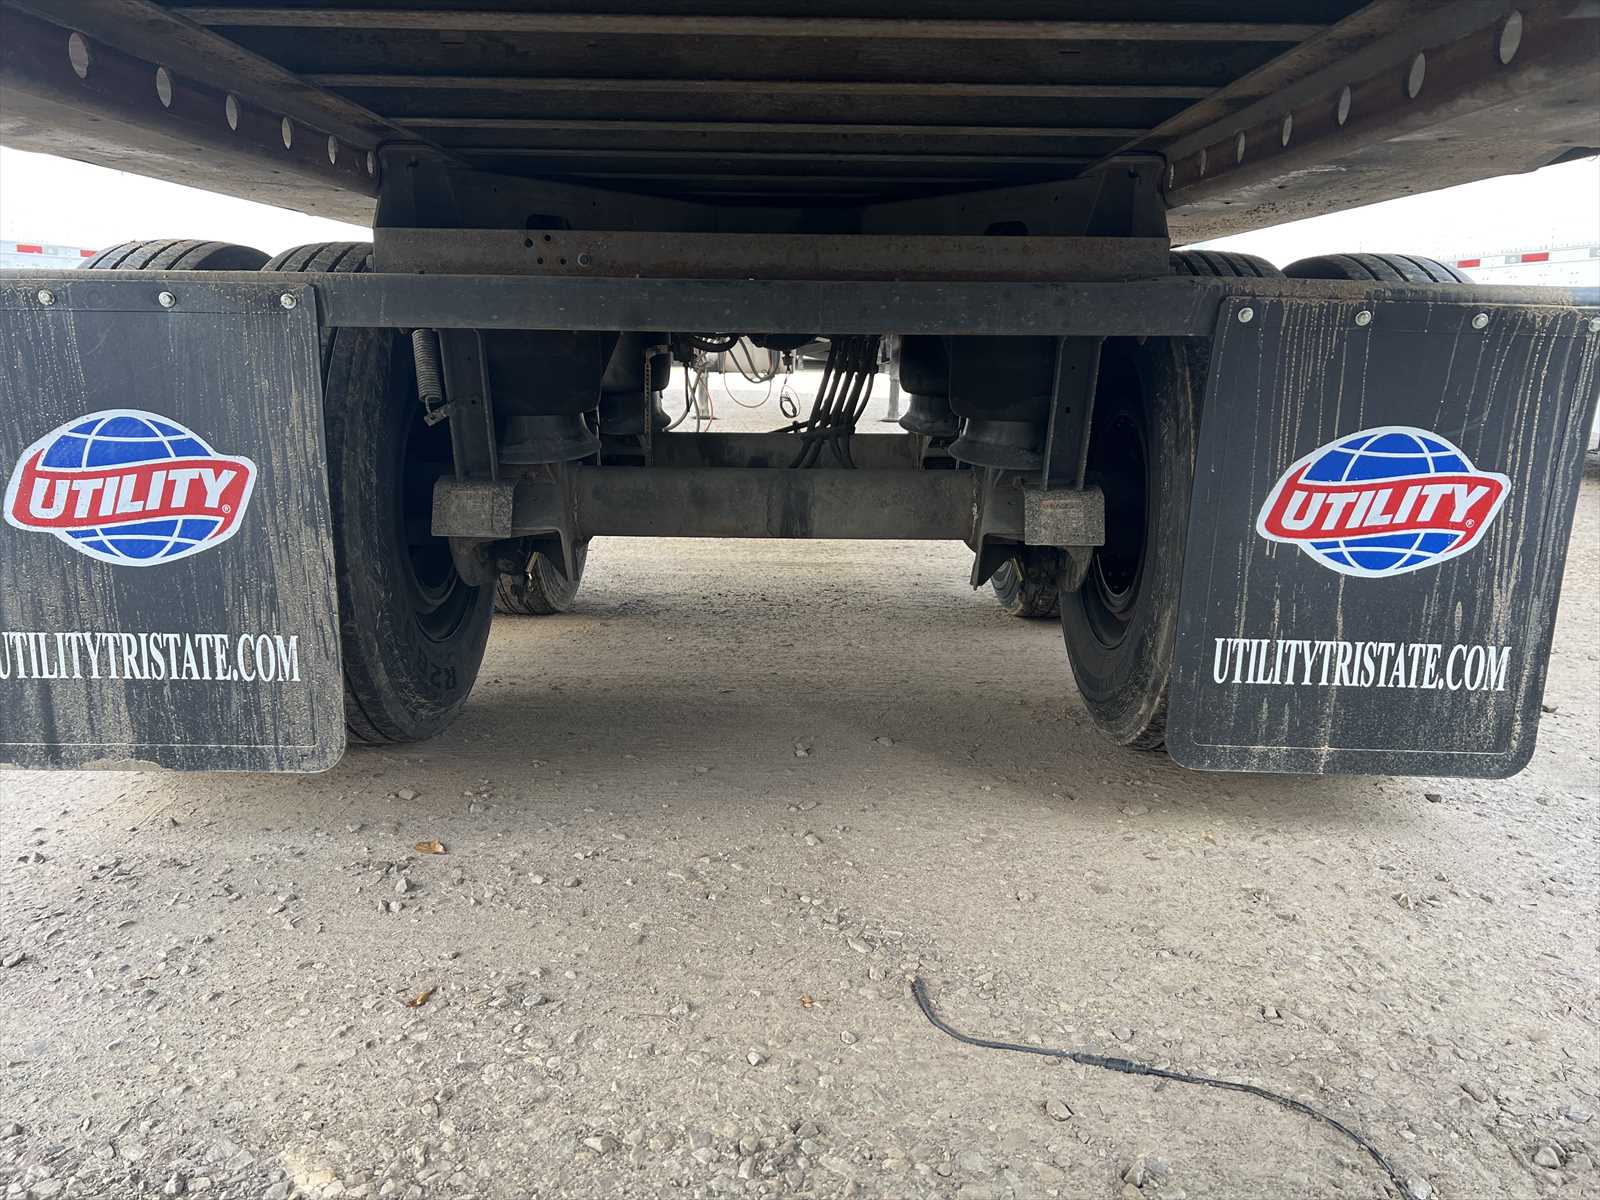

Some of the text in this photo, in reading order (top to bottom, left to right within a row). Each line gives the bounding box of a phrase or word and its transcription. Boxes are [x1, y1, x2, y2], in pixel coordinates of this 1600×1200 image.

[29, 467, 238, 520] UTILITY
[1280, 483, 1491, 531] UTILITY
[0, 631, 301, 682] UTILITYTRISTATE.COM
[1212, 637, 1512, 691] UTILITYTRISTATE.COM
